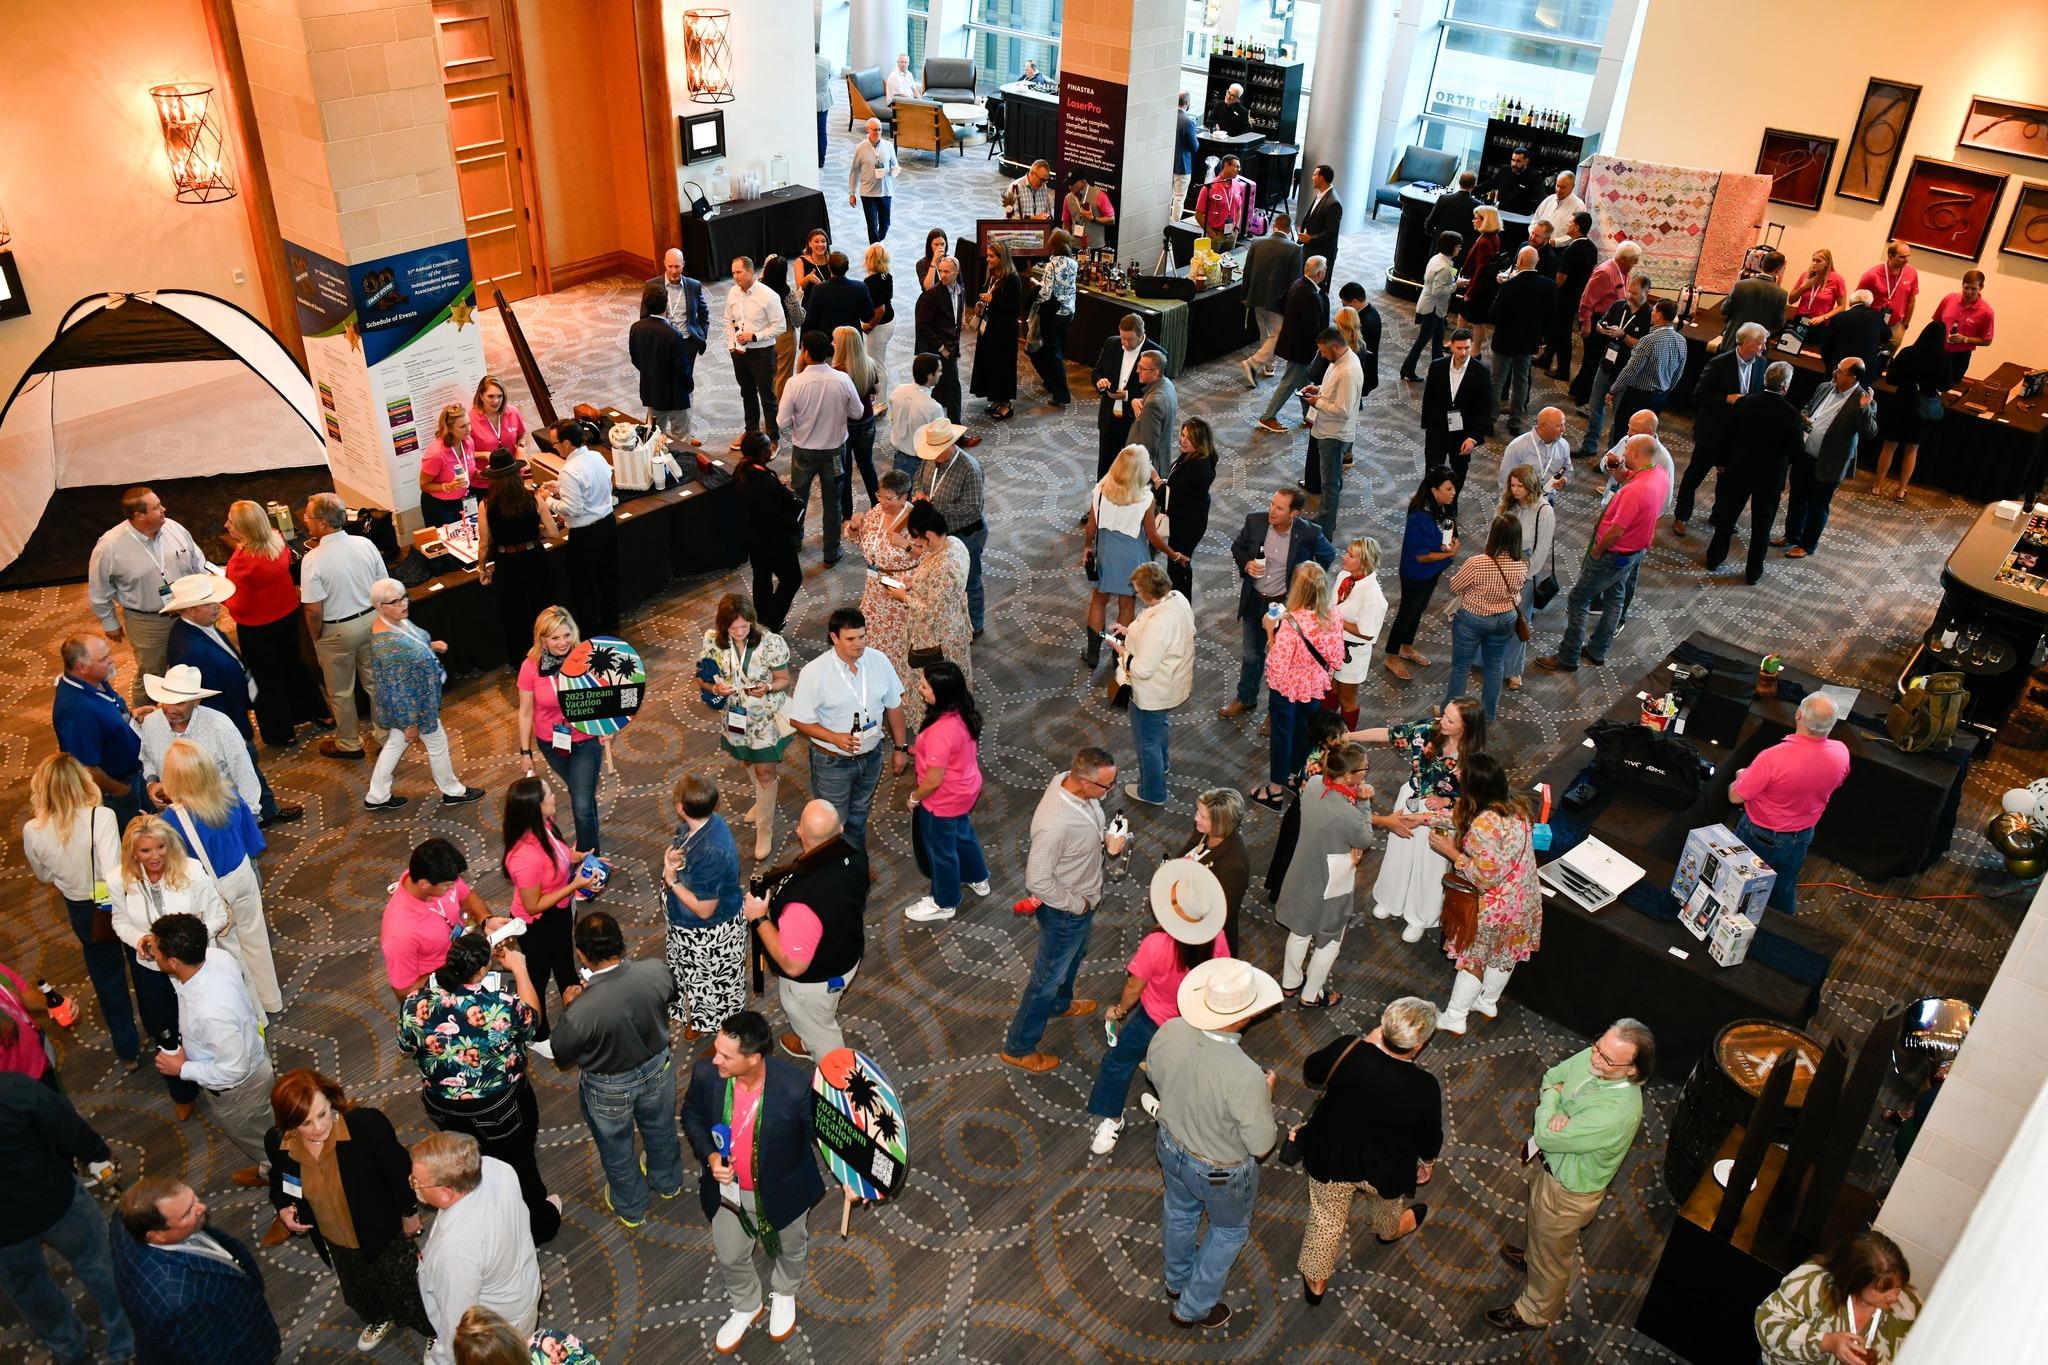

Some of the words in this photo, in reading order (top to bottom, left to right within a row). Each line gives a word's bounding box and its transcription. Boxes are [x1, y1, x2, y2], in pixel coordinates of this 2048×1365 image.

[1067, 84, 1094, 95] FINASTRA
[1067, 97, 1102, 113] LaserPro
[1075, 116, 1088, 124] single
[1065, 129, 1098, 141] documentation
[1099, 137, 1114, 145] system
[1089, 126, 1099, 134] loan
[416, 264, 432, 272] Annual
[433, 258, 459, 269] Convention
[411, 277, 440, 289] Independent
[441, 273, 459, 282] Bankers
[415, 284, 441, 295] Association
[366, 317, 391, 329] Schedule
[398, 310, 417, 320] Events
[565, 692, 584, 700] 2025
[586, 689, 613, 698] Dream
[565, 698, 601, 708] Vacation
[566, 707, 595, 716] Tickets
[1734, 1051, 1758, 1080] WHISKEY
[816, 1108, 852, 1146] Vacation
[817, 1098, 836, 1120] 2025
[838, 1115, 866, 1147] Dream
[815, 1117, 843, 1149] Tickets
